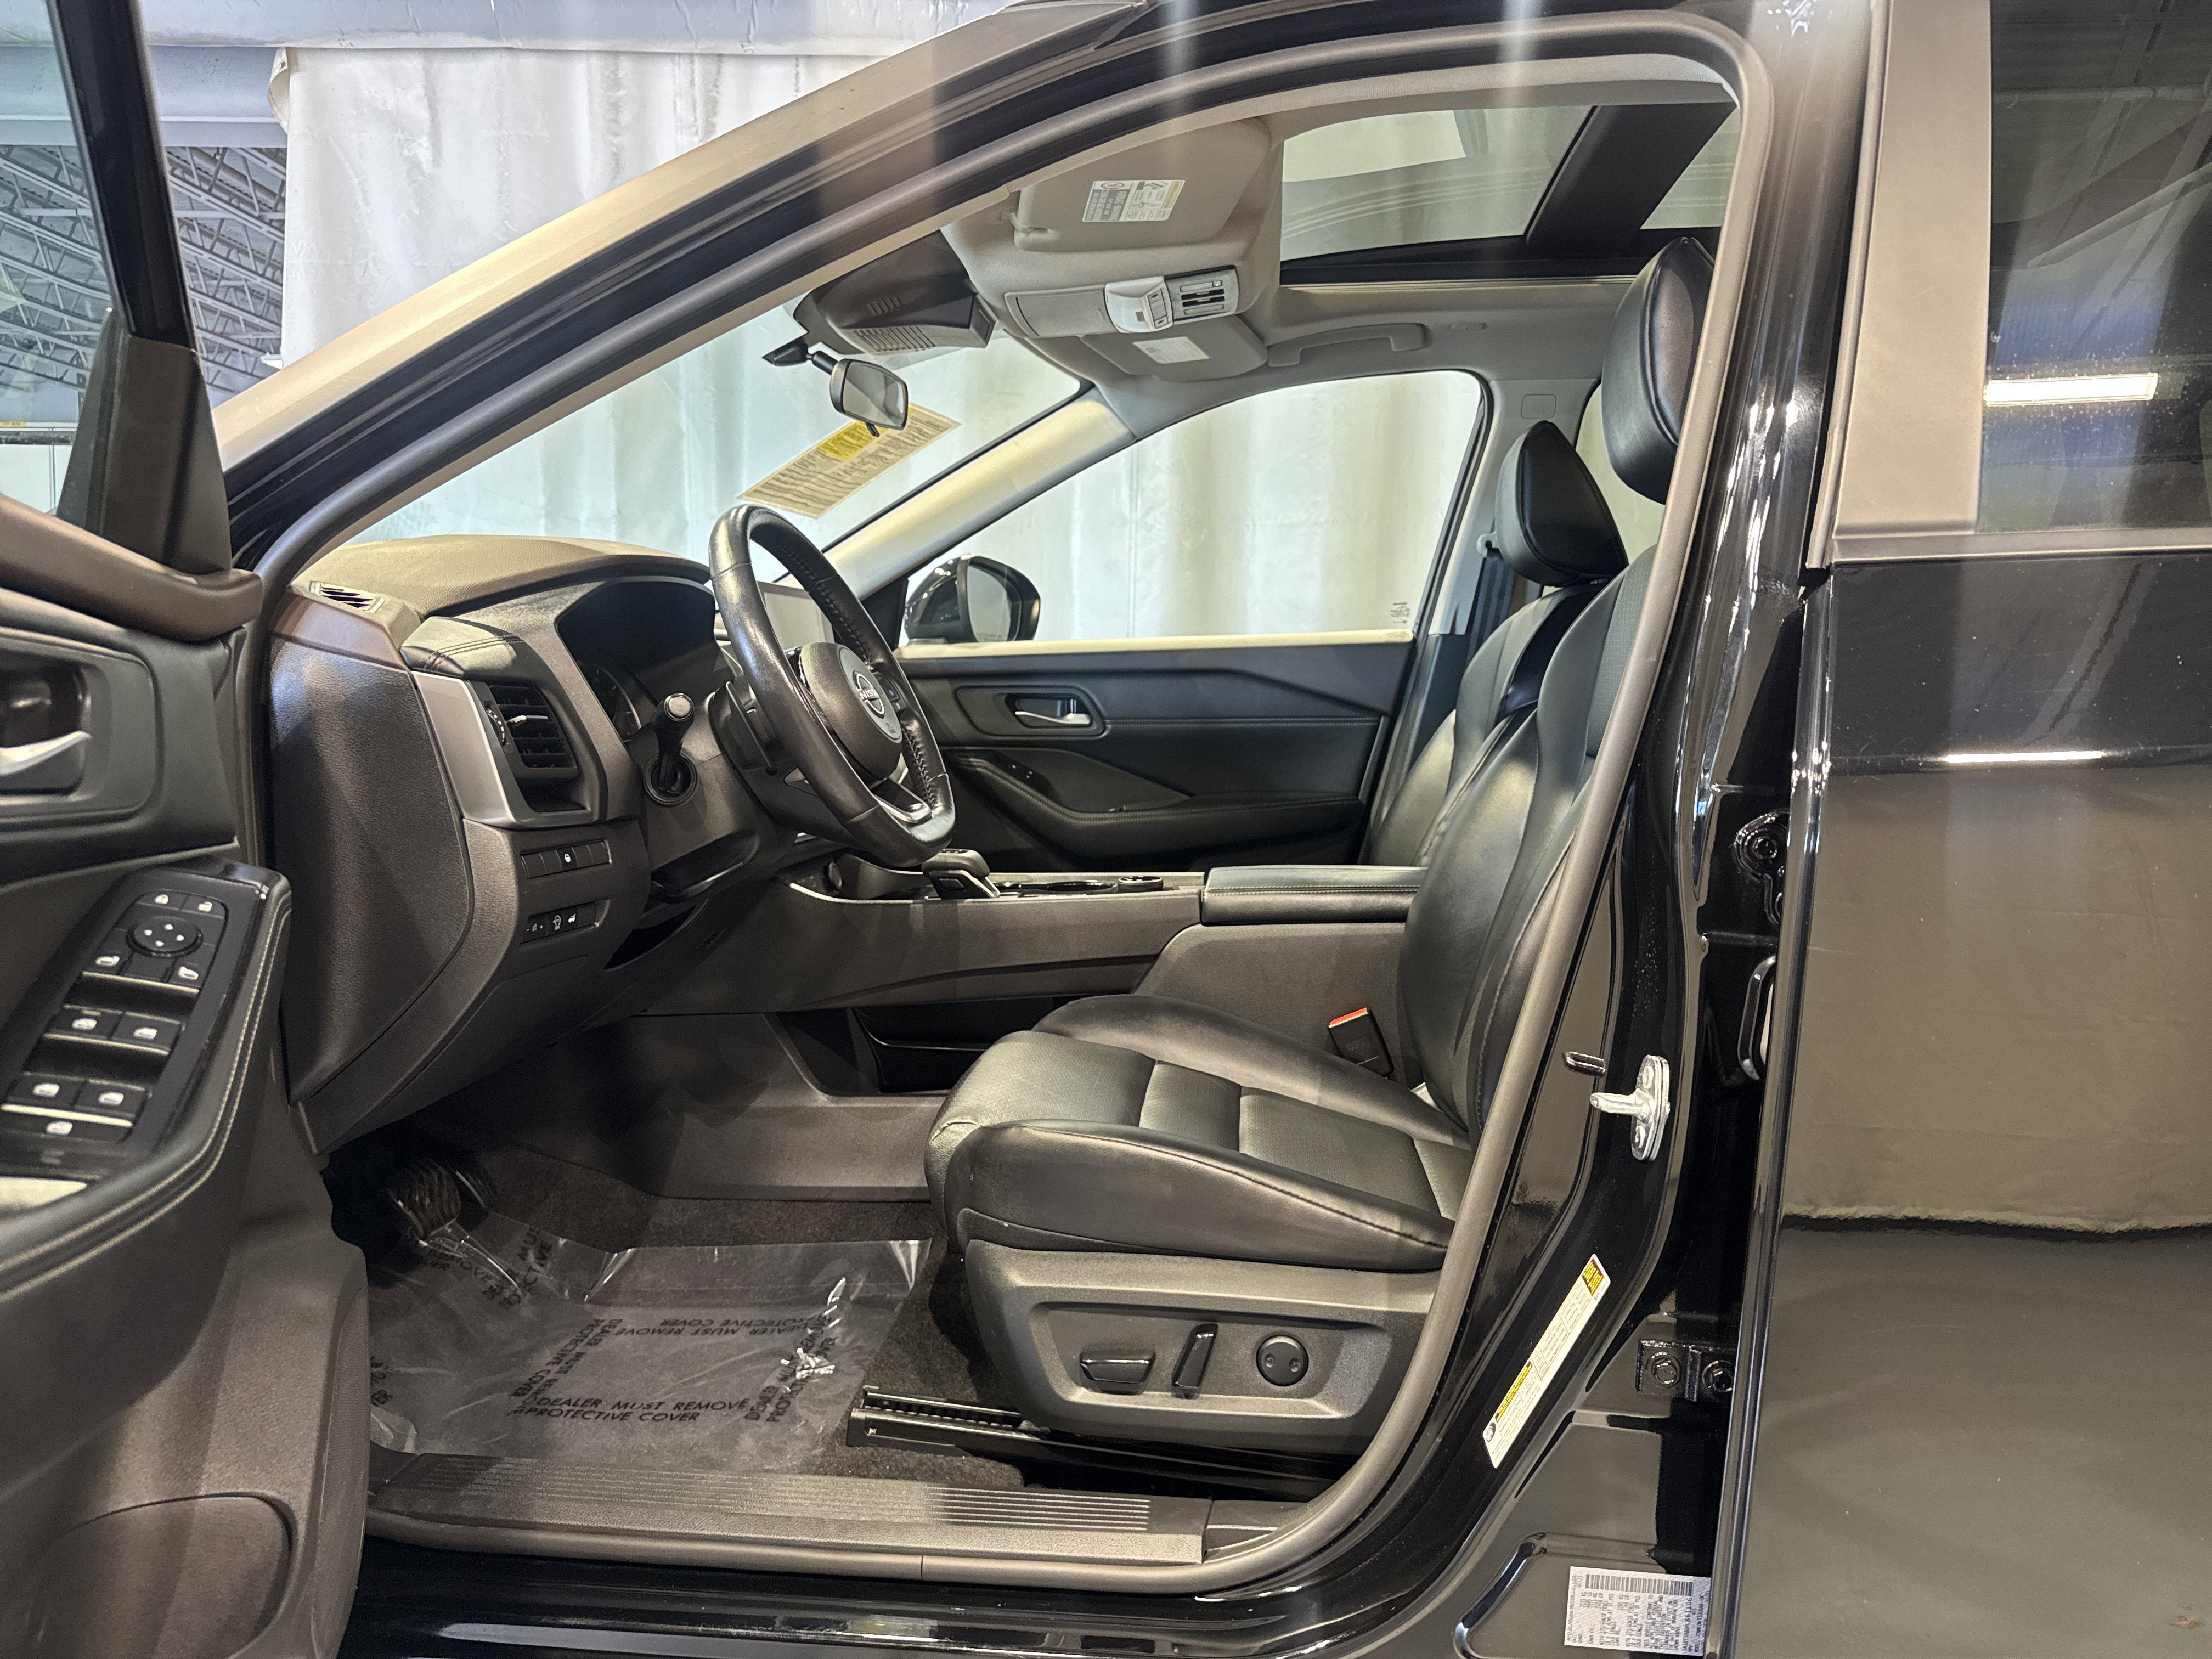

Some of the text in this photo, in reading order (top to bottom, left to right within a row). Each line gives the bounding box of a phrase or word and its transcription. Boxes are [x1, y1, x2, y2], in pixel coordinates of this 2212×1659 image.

[860, 689, 878, 699] NISS
[660, 1318, 714, 1327] COVER
[749, 1322, 809, 1335] DEALER
[584, 1319, 623, 1347] DEALER
[615, 1327, 685, 1335] REMOVE
[510, 1319, 605, 1397] PROTECTIVE COVER
[555, 1351, 586, 1374] MUST
[537, 1397, 751, 1411] DEALER MUST REMOVE
[745, 1385, 776, 1420] DEALER
[524, 1408, 701, 1421] PROTECTIVE COVER
